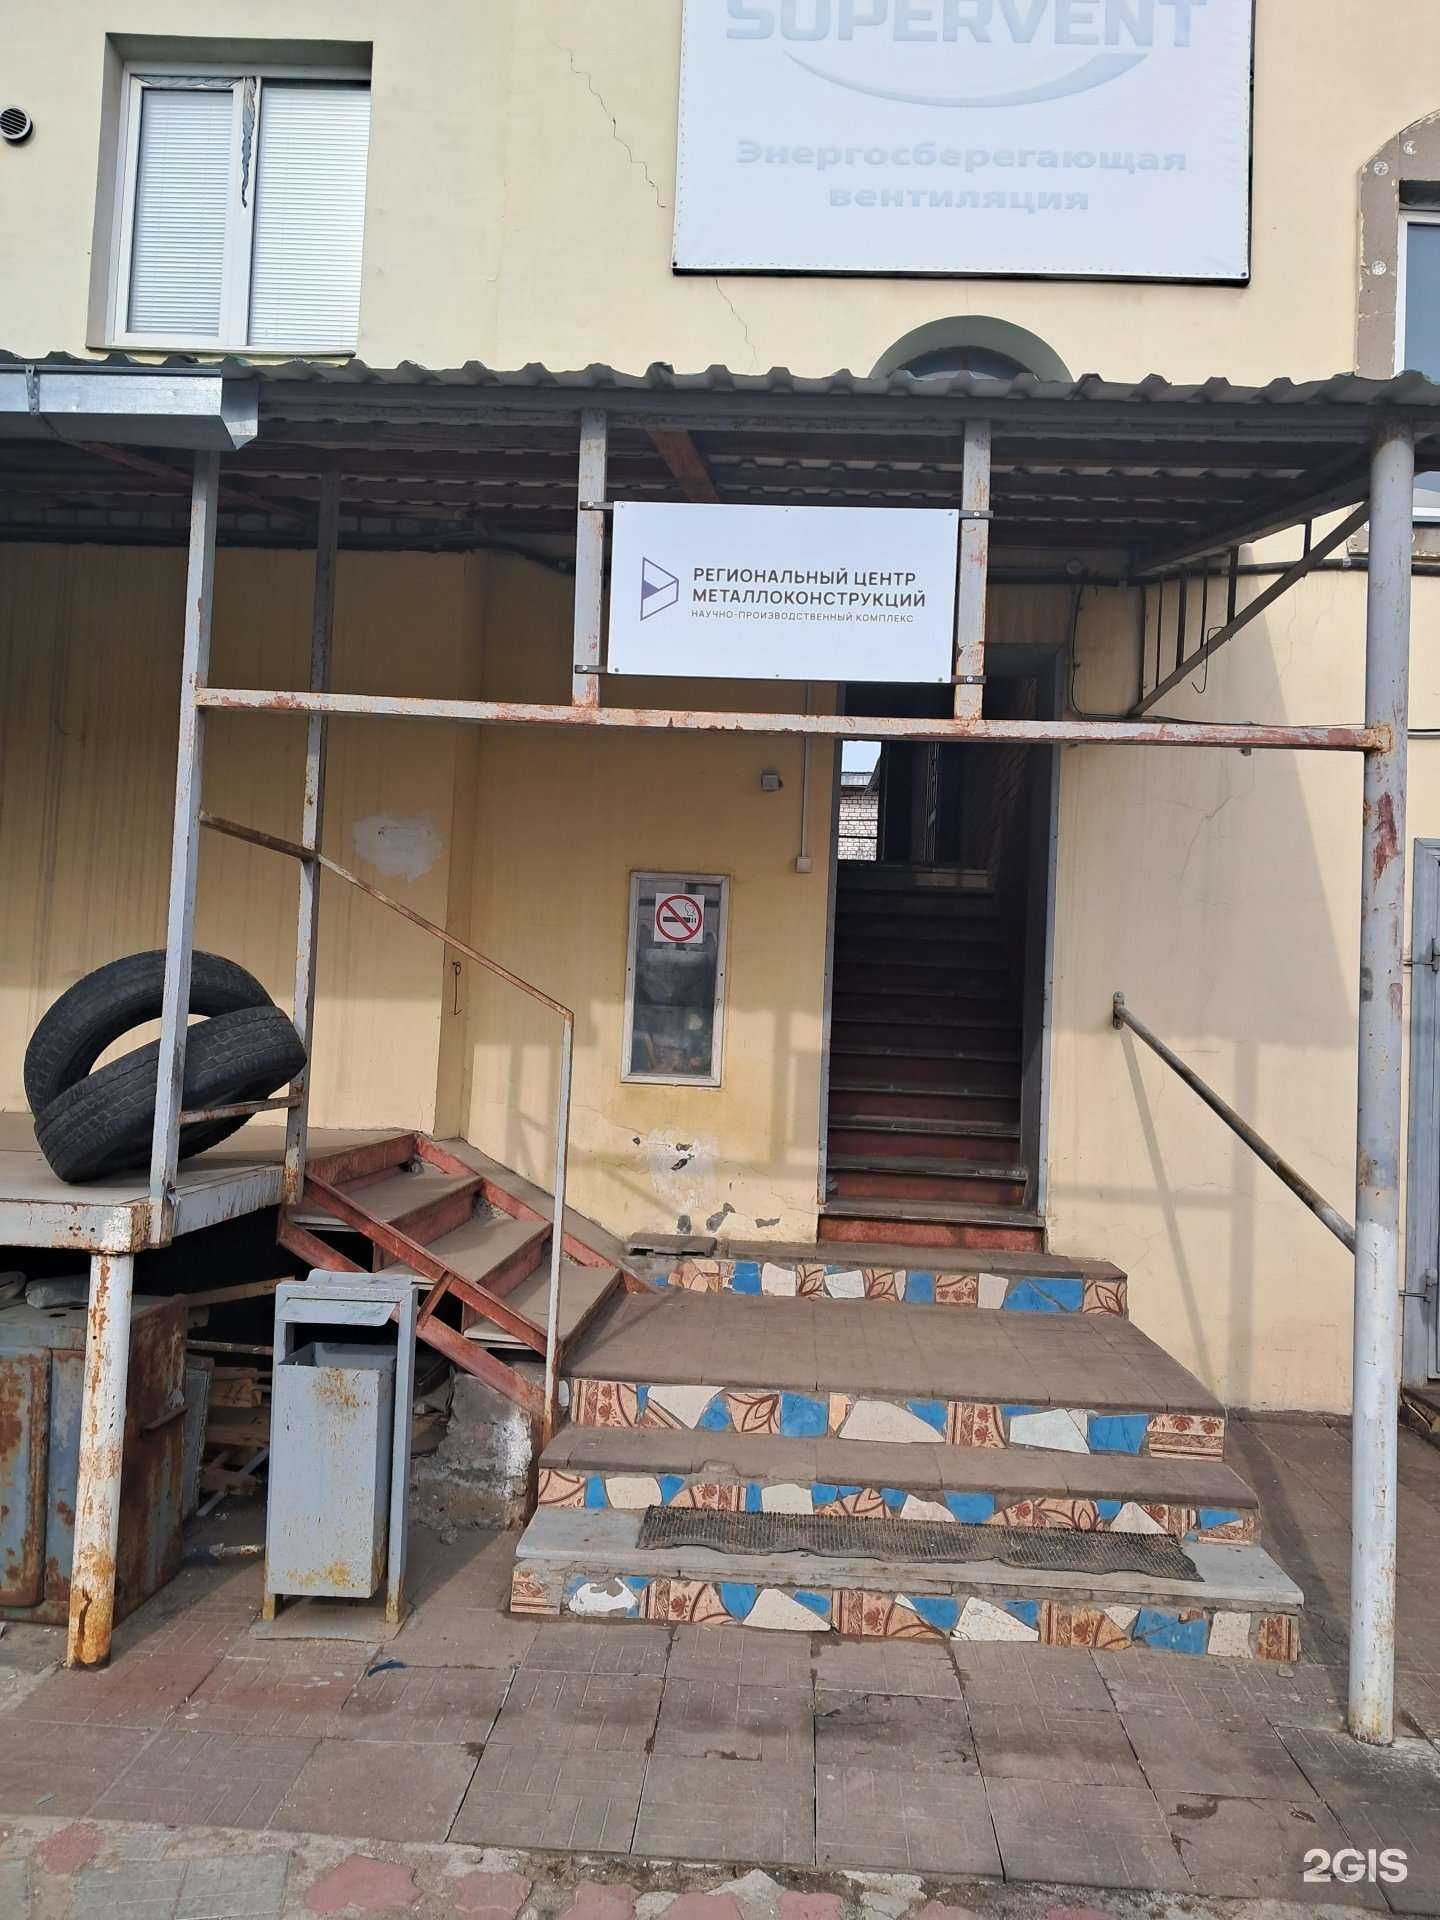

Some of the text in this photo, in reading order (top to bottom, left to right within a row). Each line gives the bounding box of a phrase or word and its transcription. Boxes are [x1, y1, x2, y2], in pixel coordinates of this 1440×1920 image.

[726, 0, 1208, 48] SUPERVENT
[737, 139, 1187, 173] Энергосберегающая
[828, 186, 1089, 213] вентиляция
[693, 567, 916, 586] РЕГИОНАЛЬНЫЙ ЦЕНТР
[692, 588, 926, 608] МЕТАЛЛОКОНСТРУКЦИЙ
[691, 610, 914, 623] НАУЧНО-ПРОИЗВОДСТВЕННЫЙ КОМПЛЕКС
